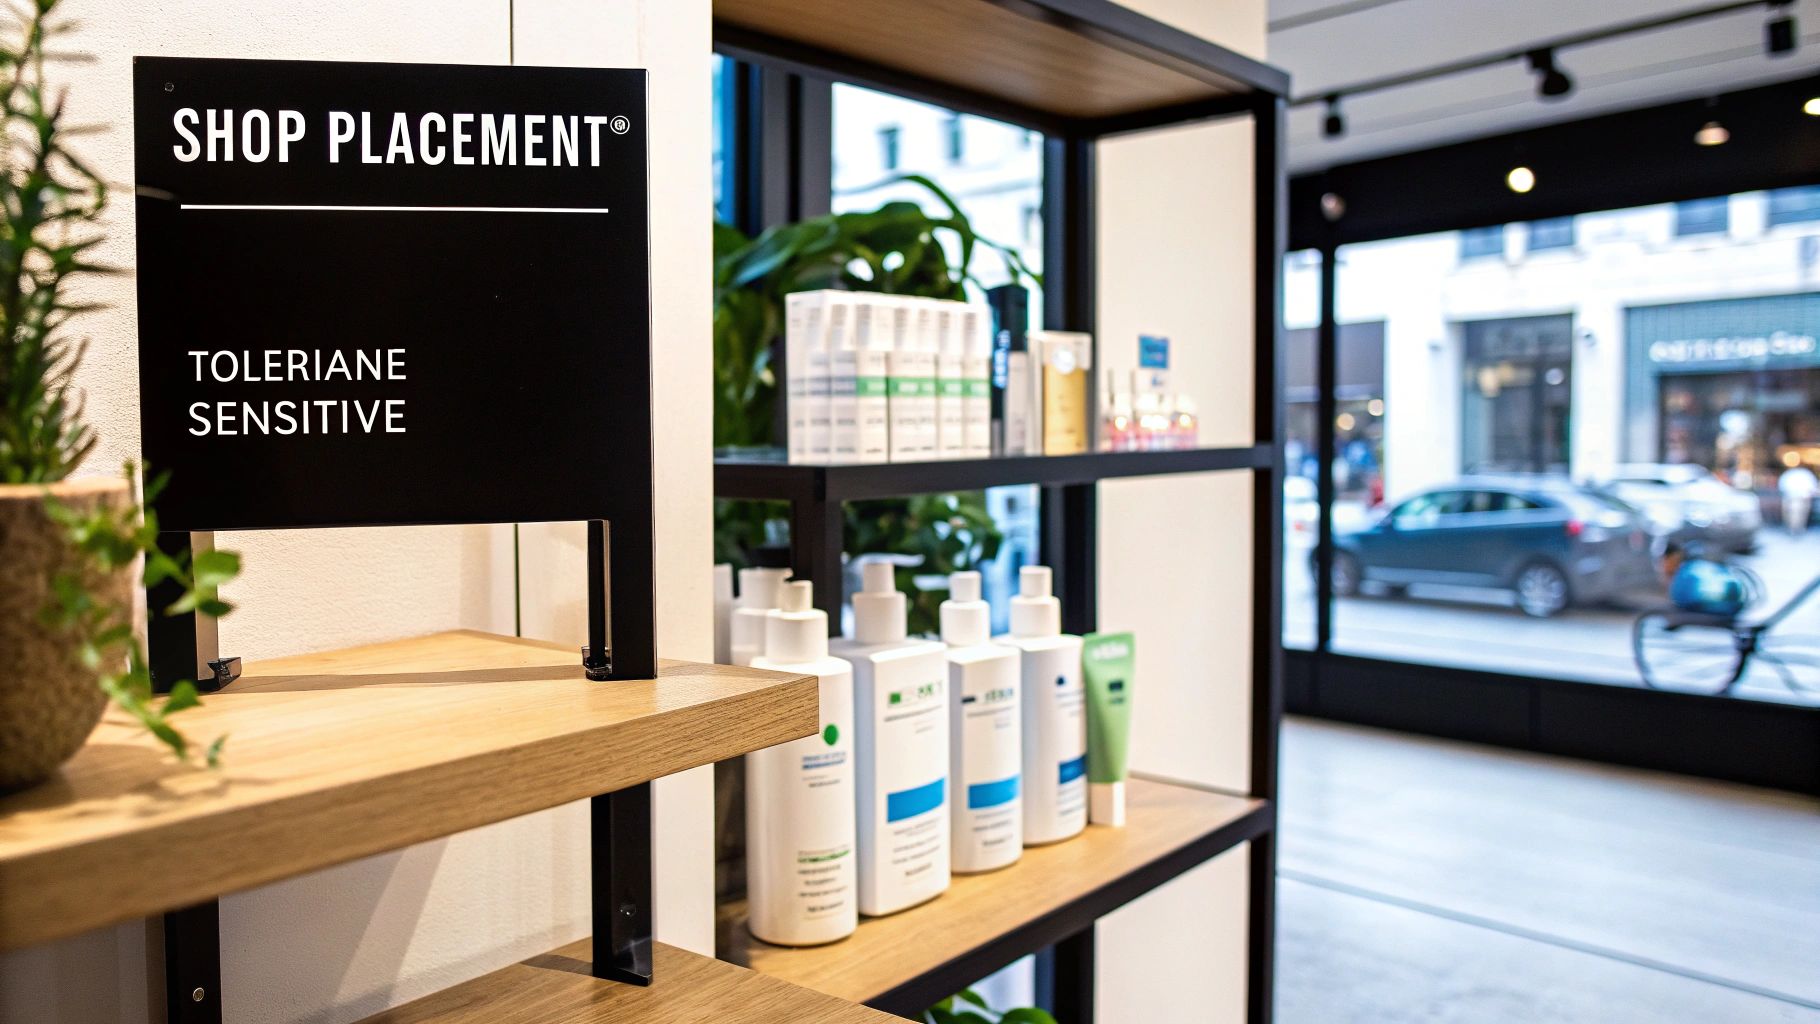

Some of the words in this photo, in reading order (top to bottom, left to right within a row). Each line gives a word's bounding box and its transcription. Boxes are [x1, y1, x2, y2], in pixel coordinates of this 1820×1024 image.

[172, 107, 306, 163] SHOP
[187, 348, 407, 383] TOLERIANE
[187, 399, 406, 437] SENSITIVE
